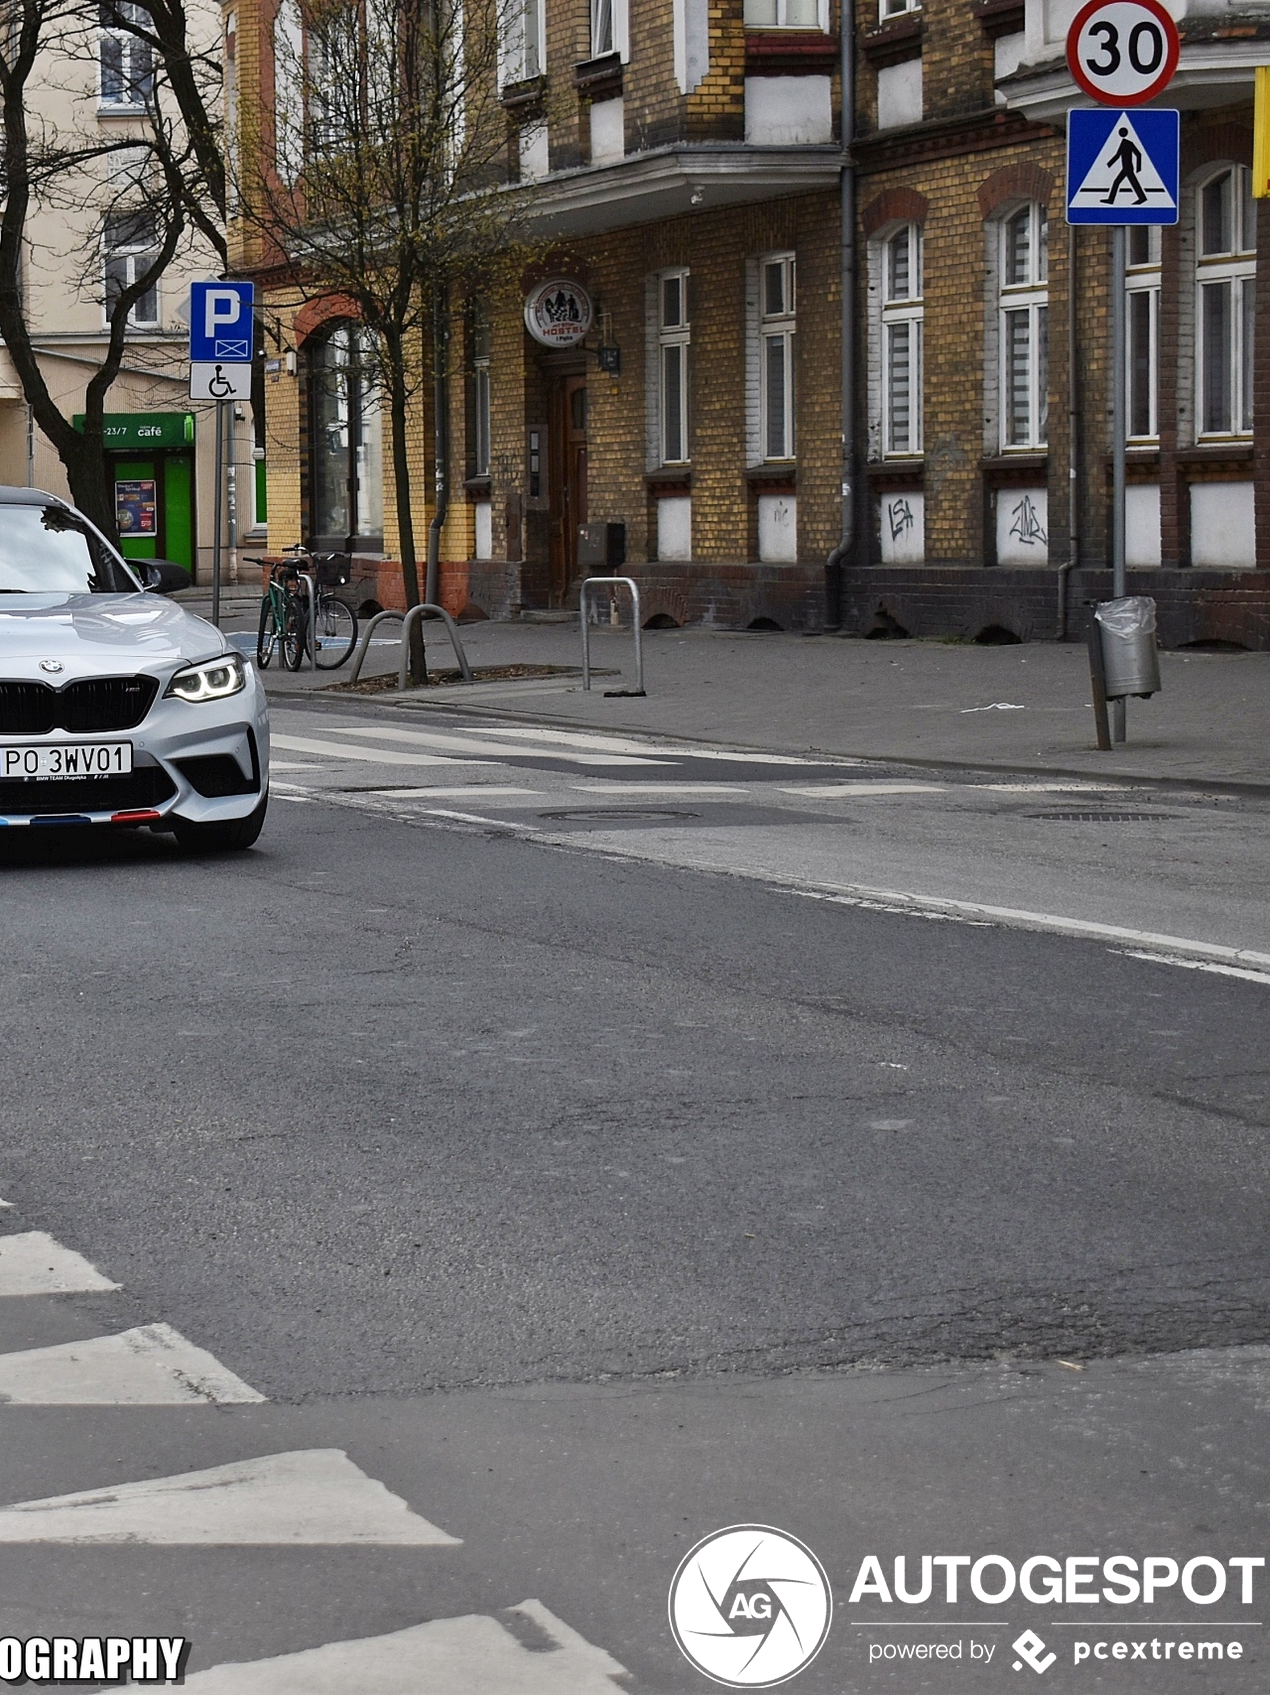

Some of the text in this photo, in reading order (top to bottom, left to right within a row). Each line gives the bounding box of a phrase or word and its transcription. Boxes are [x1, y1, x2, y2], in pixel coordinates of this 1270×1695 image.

[1086, 21, 1163, 76] 30
[205, 289, 241, 338] P
[543, 327, 585, 336] HOSTEL
[137, 426, 162, 437] café
[6, 747, 121, 774] PO 3WV01
